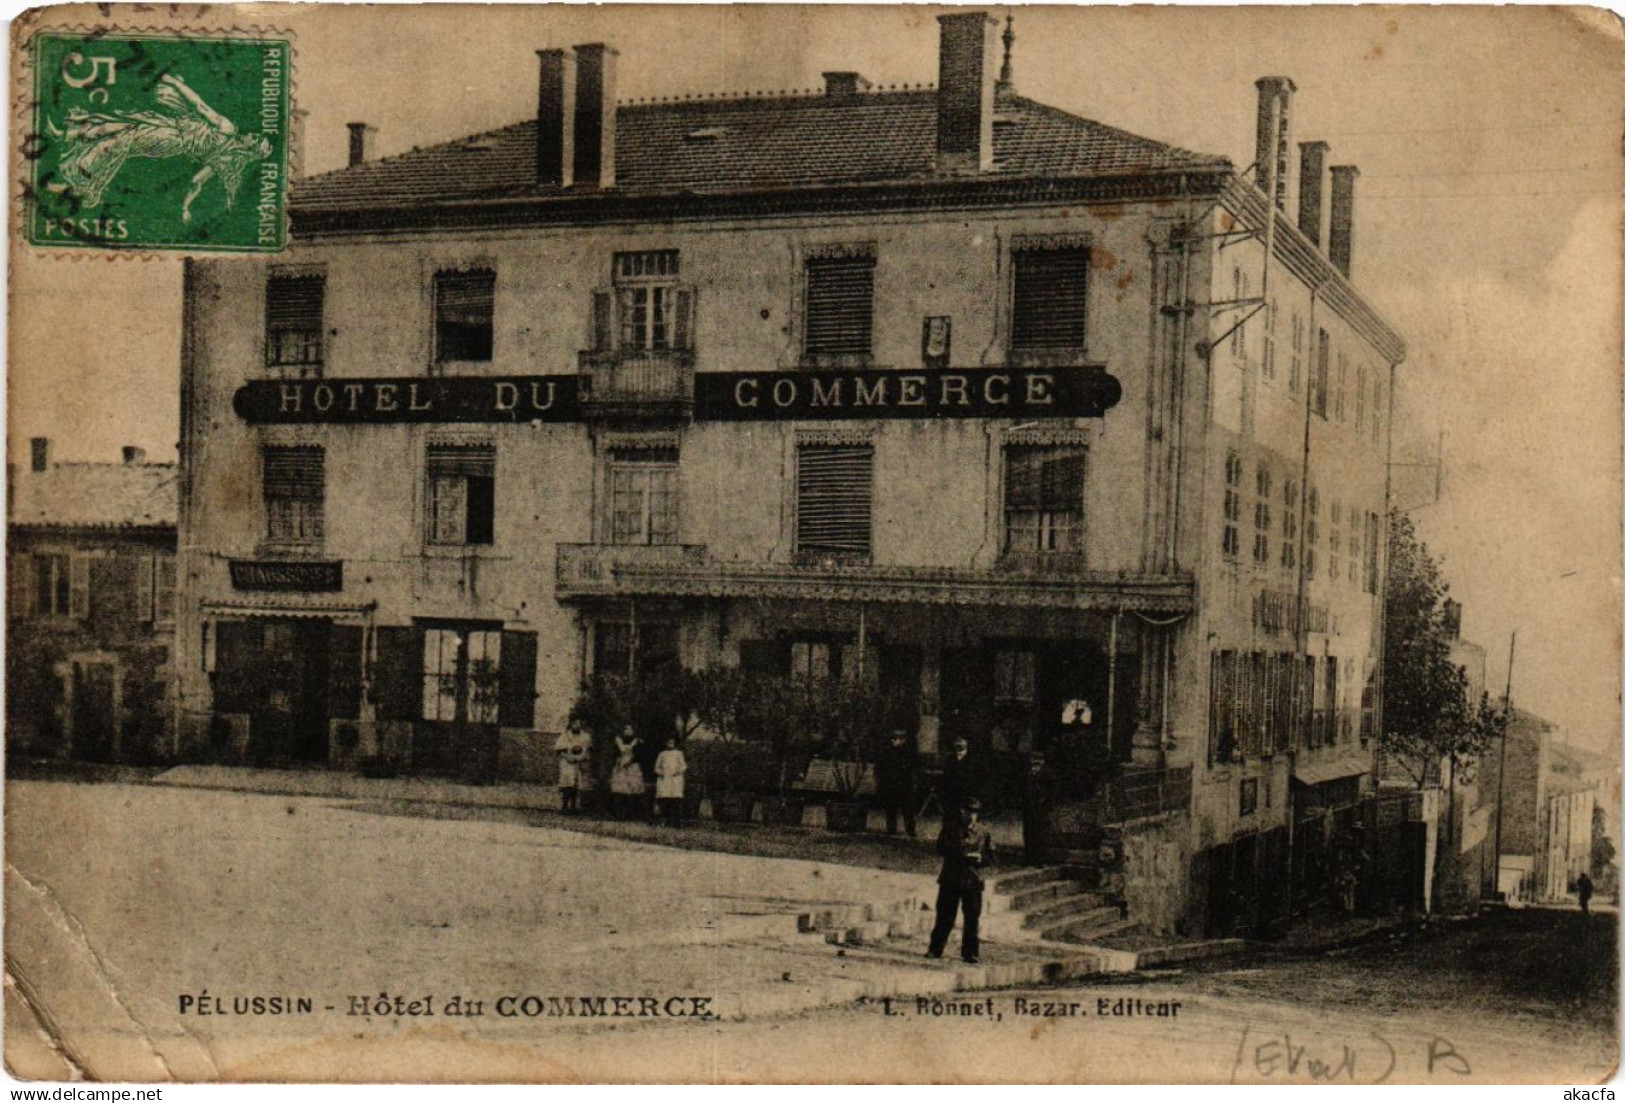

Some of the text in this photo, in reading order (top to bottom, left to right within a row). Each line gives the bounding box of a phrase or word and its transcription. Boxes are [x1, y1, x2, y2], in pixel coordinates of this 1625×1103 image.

[256, 48, 281, 244] REPUBLIQUE FRANÇAISE
[45, 219, 129, 238] POSTES
[494, 382, 556, 411] DU
[733, 374, 1055, 408] COMMERCE
